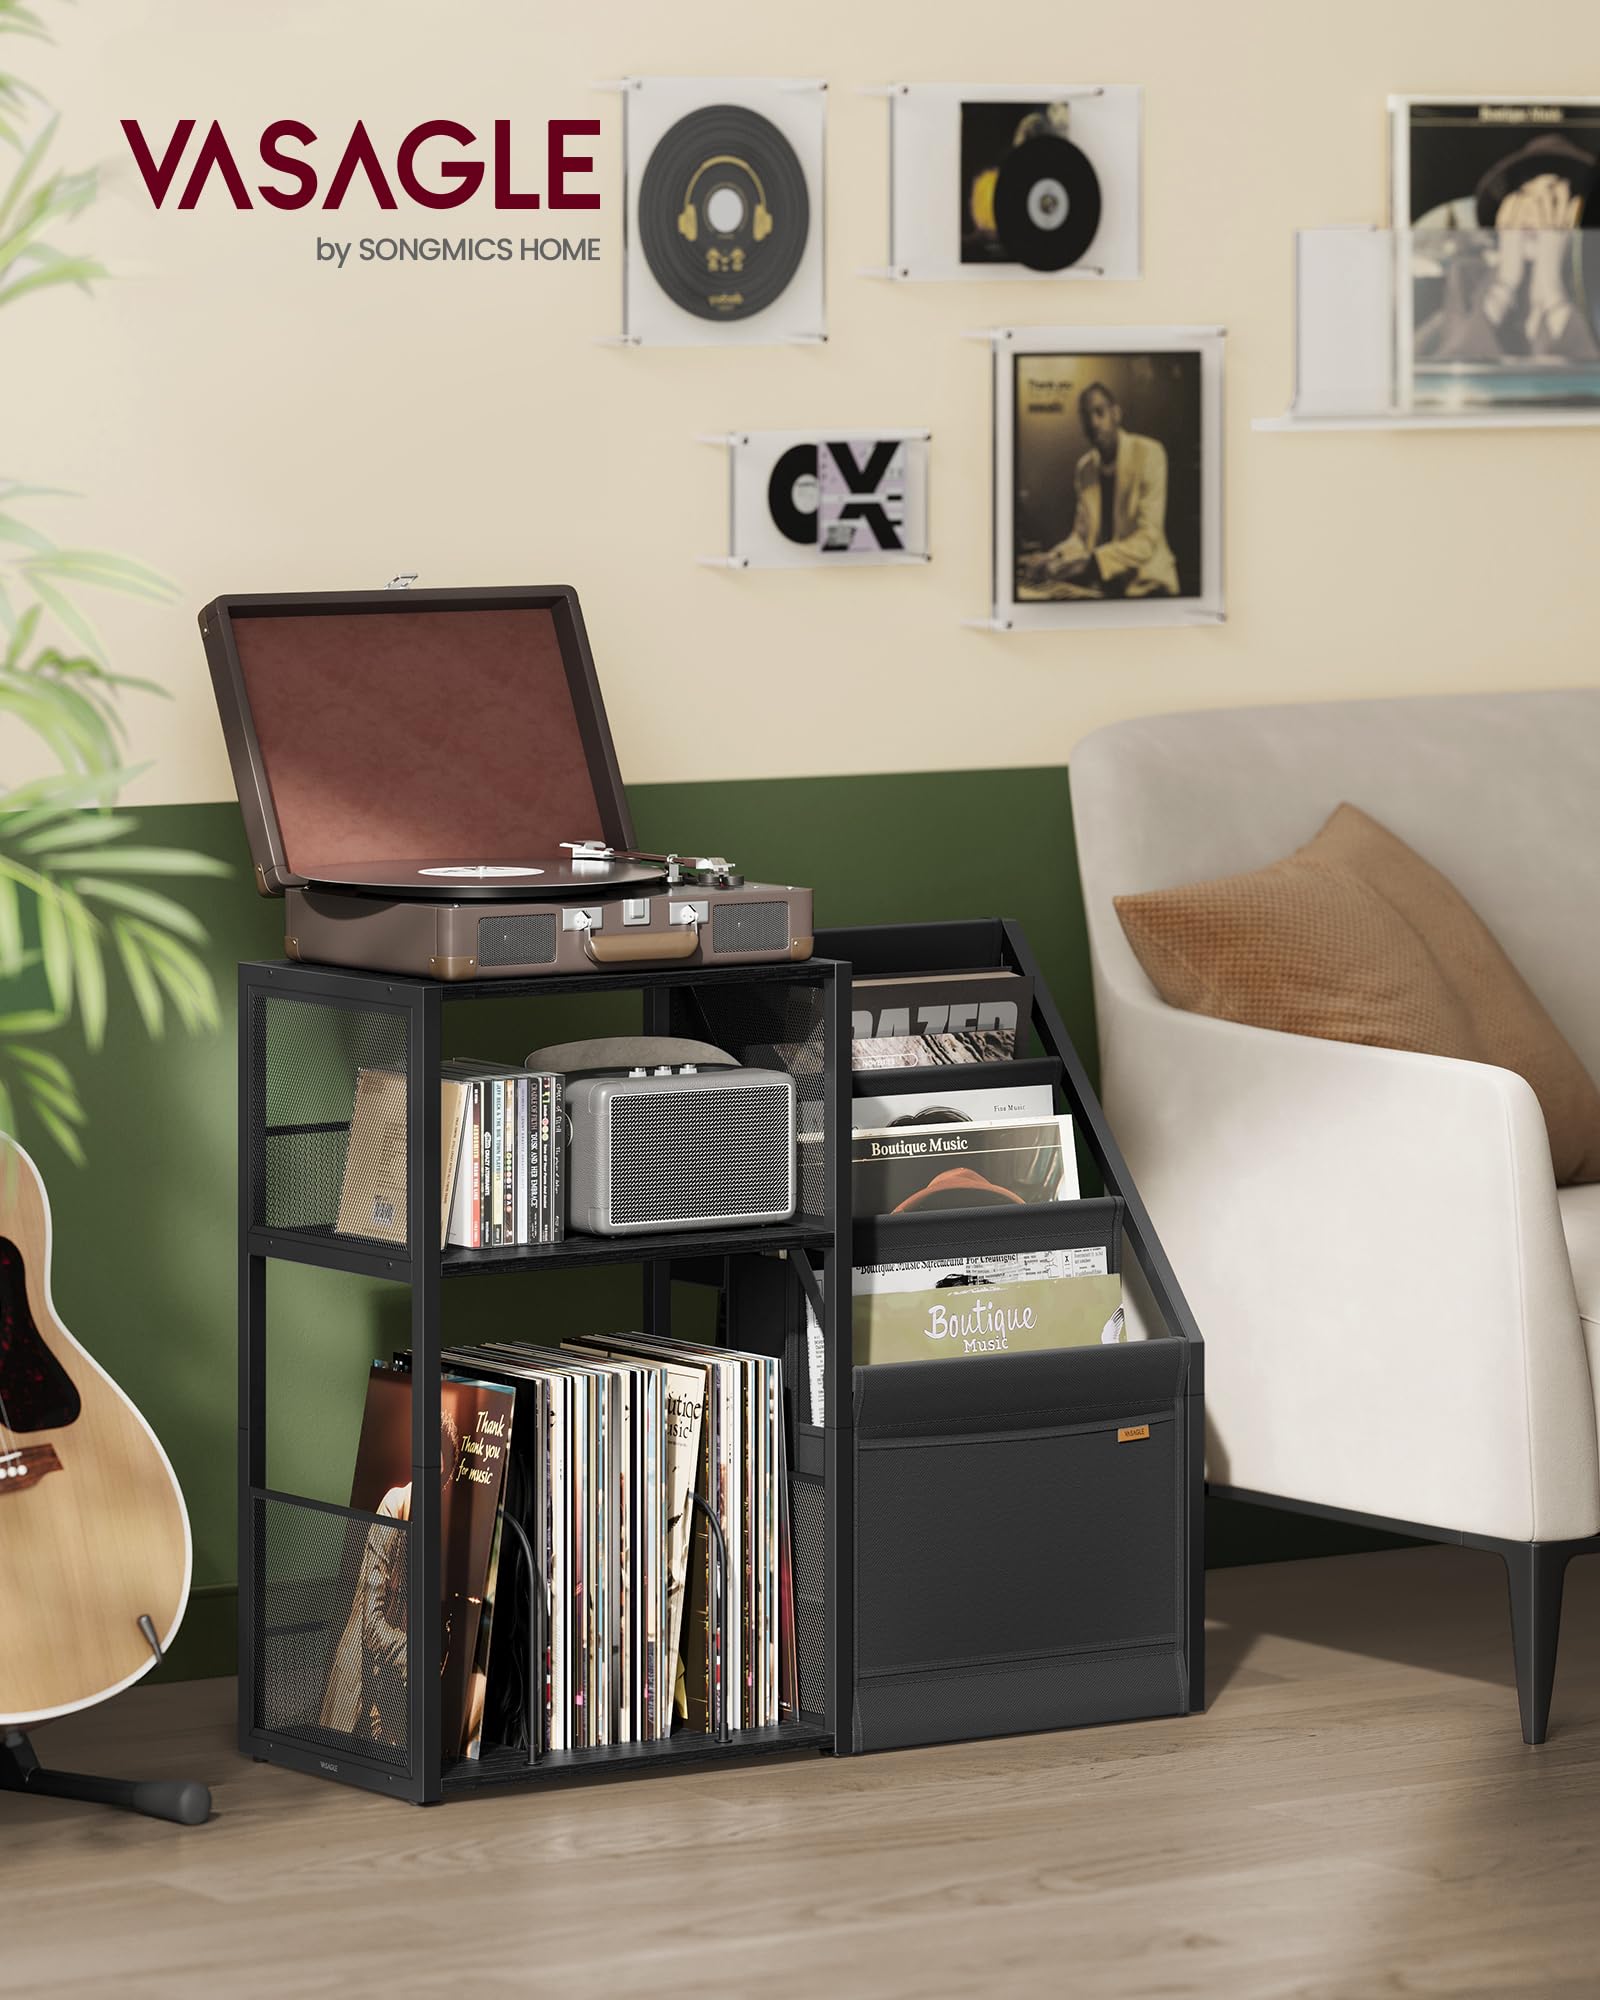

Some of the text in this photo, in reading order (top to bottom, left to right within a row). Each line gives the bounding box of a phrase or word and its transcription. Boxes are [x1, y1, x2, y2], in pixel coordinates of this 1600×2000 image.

[871, 1136, 968, 1157] Boutique Music
[924, 1299, 1038, 1340] Boutique
[964, 1337, 1008, 1353] Music
[475, 1411, 505, 1438] Thank
[461, 1435, 501, 1462] Thank you
[456, 1458, 493, 1485] for music
